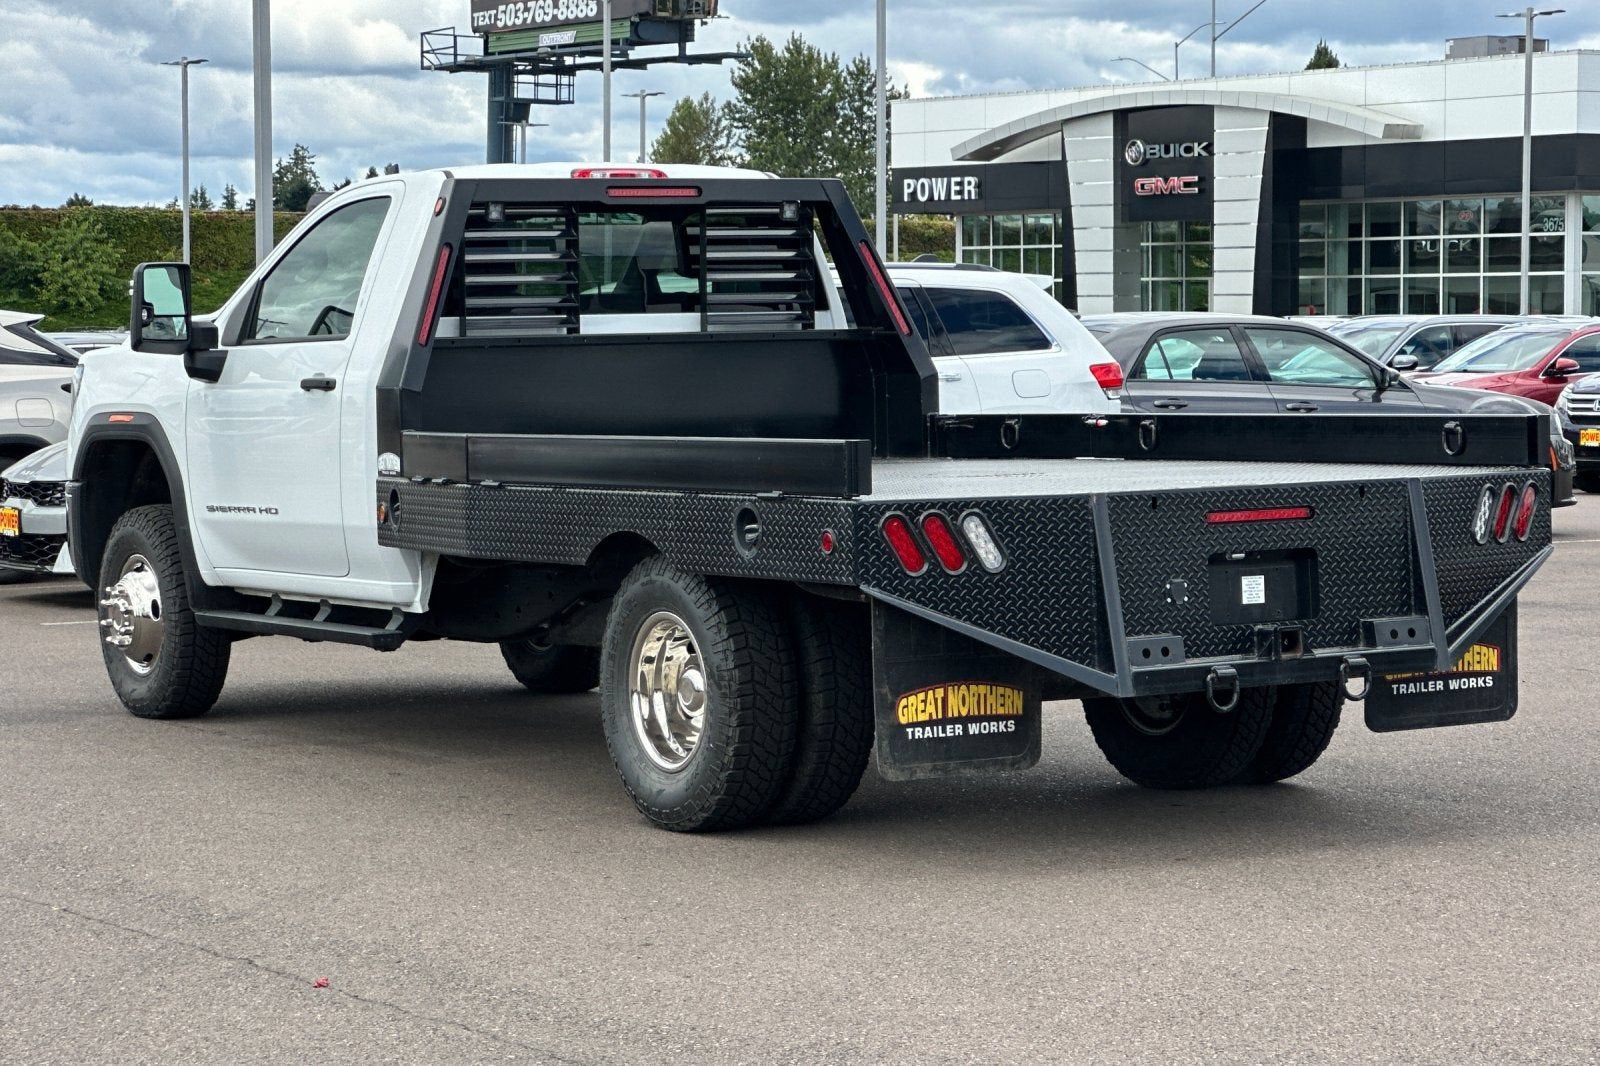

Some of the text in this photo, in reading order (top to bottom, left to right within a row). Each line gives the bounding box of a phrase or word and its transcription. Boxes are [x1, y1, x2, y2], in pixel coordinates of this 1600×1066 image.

[473, 0, 598, 27] TEXT 503-769-8888
[1145, 142, 1209, 158] BUICK
[903, 176, 978, 201] POWER
[1135, 175, 1199, 195] GMC
[1543, 217, 1564, 232] 3675
[1413, 238, 1473, 253] BUCK
[206, 505, 279, 515] SIERRA HD
[1392, 676, 1494, 695] TRAILER WORKS
[897, 684, 1023, 725] GREAT NORTHERN
[906, 720, 1016, 740] TRAILER WORKS
